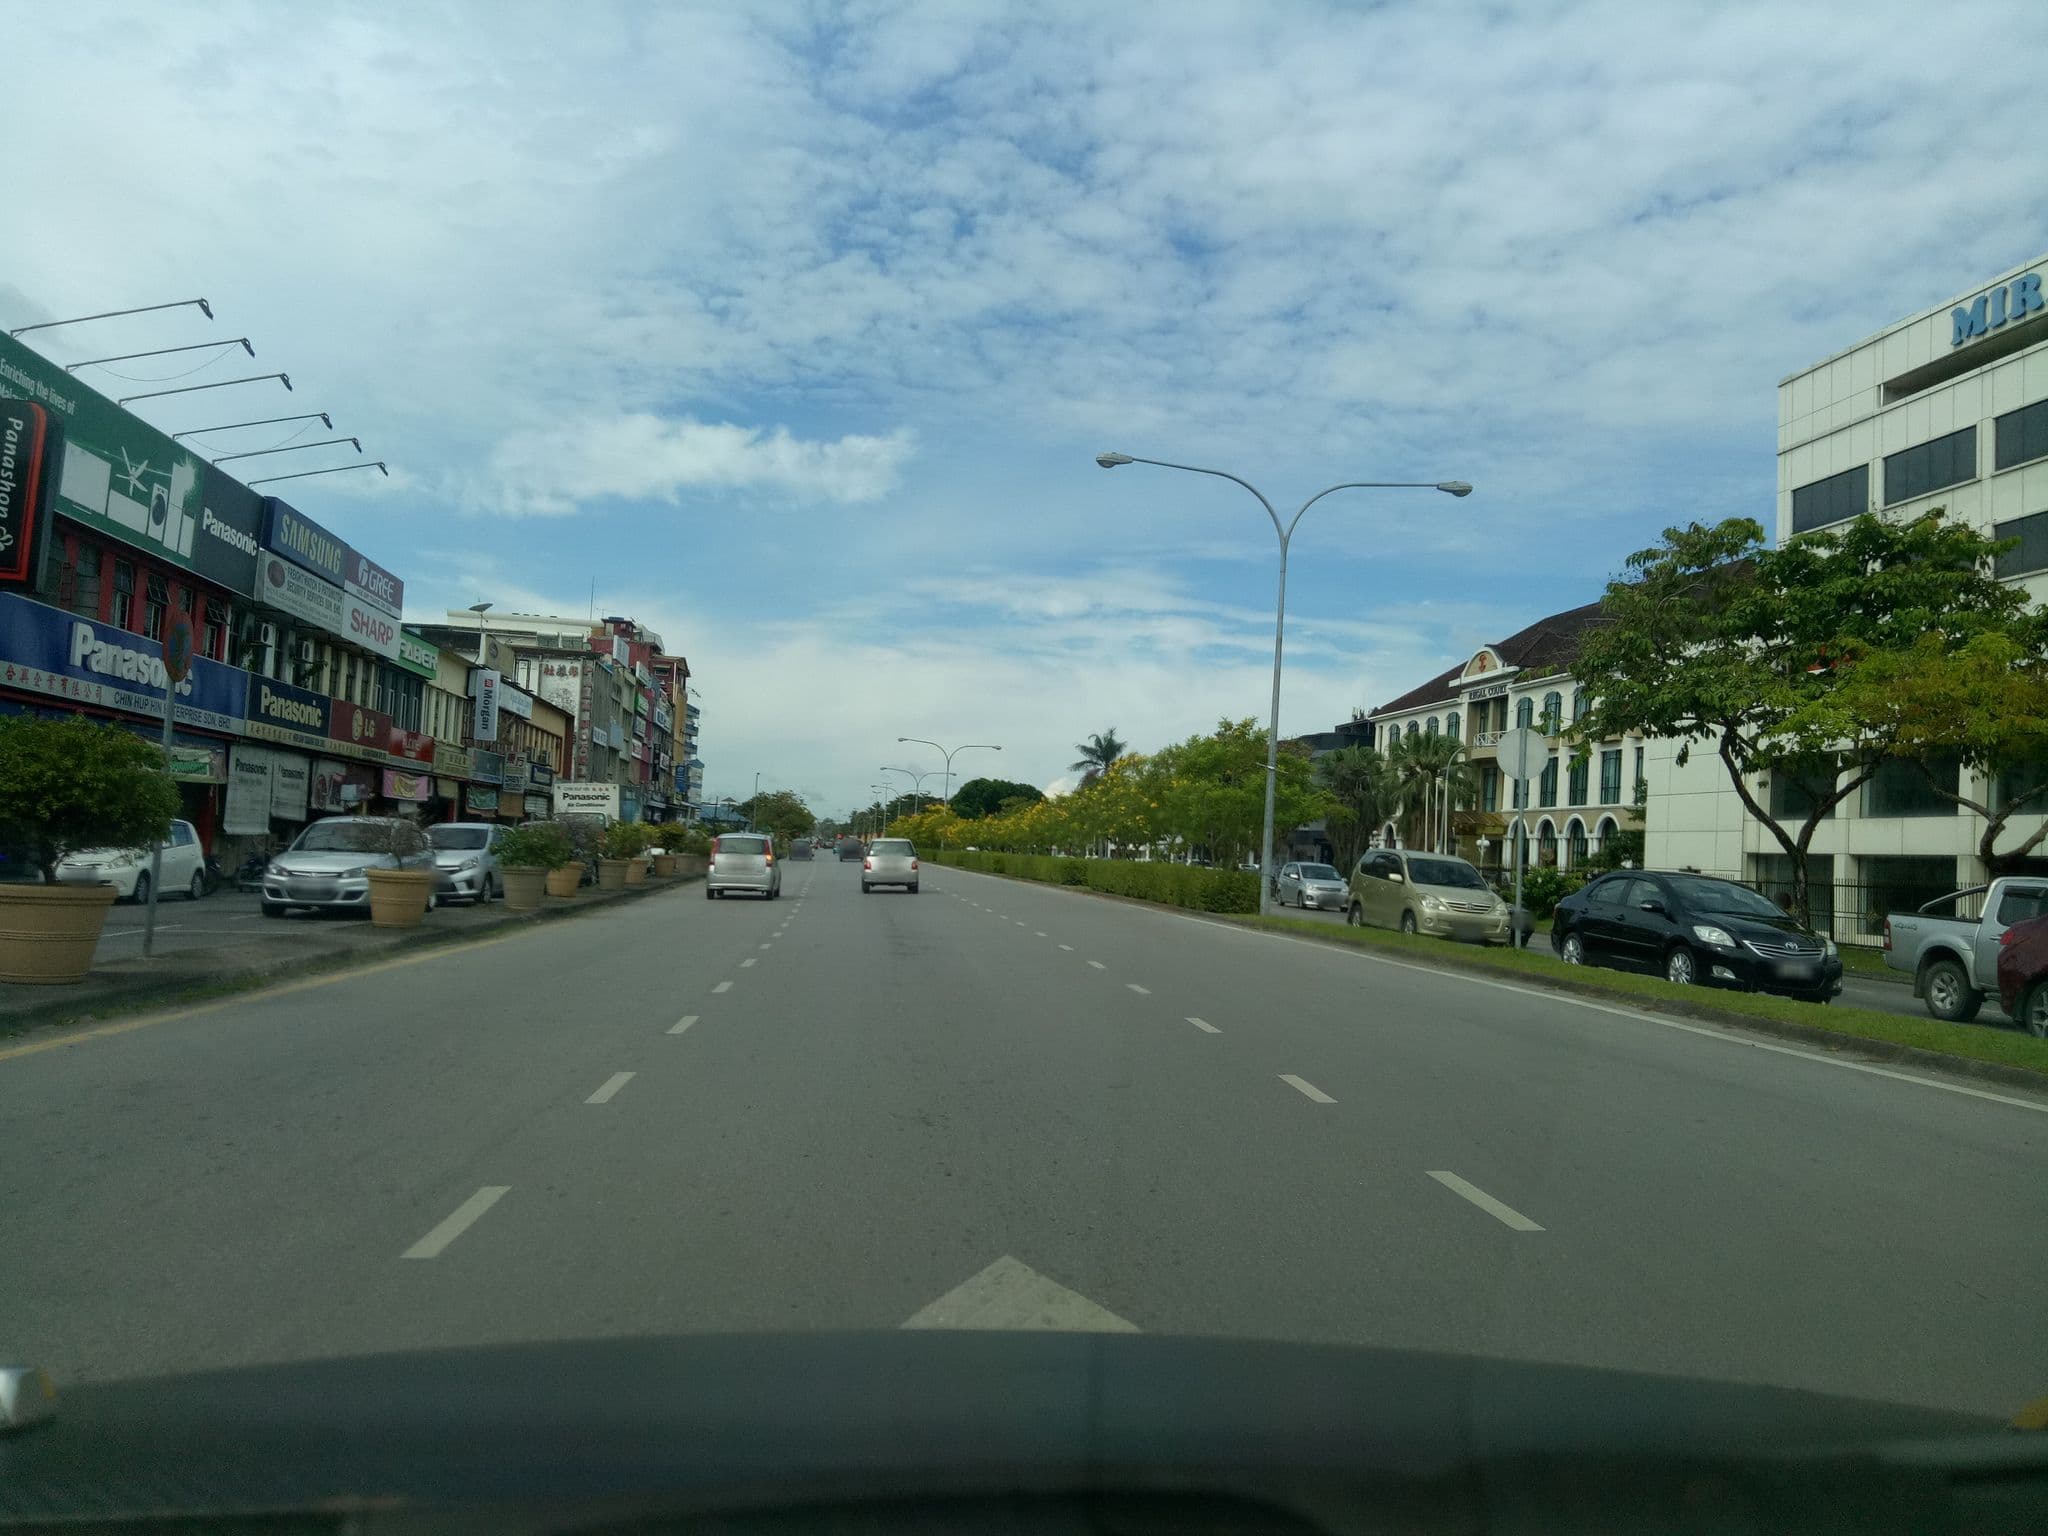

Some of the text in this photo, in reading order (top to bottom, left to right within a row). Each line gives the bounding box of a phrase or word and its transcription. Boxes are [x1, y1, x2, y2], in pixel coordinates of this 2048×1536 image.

[36, 380, 49, 400] the
[202, 507, 258, 556] Panasonic
[281, 514, 342, 575] SAMSUNG
[368, 571, 394, 602] GREE
[351, 608, 394, 646] SHARP
[114, 690, 132, 707] CHIN
[134, 694, 149, 710] HUP
[163, 704, 203, 723] EERPRISE
[261, 685, 322, 729] Panasonic
[481, 689, 493, 730] Morgan
[364, 718, 376, 737] LG
[235, 758, 267, 776] Panasonic
[562, 792, 610, 801] Panasonic
